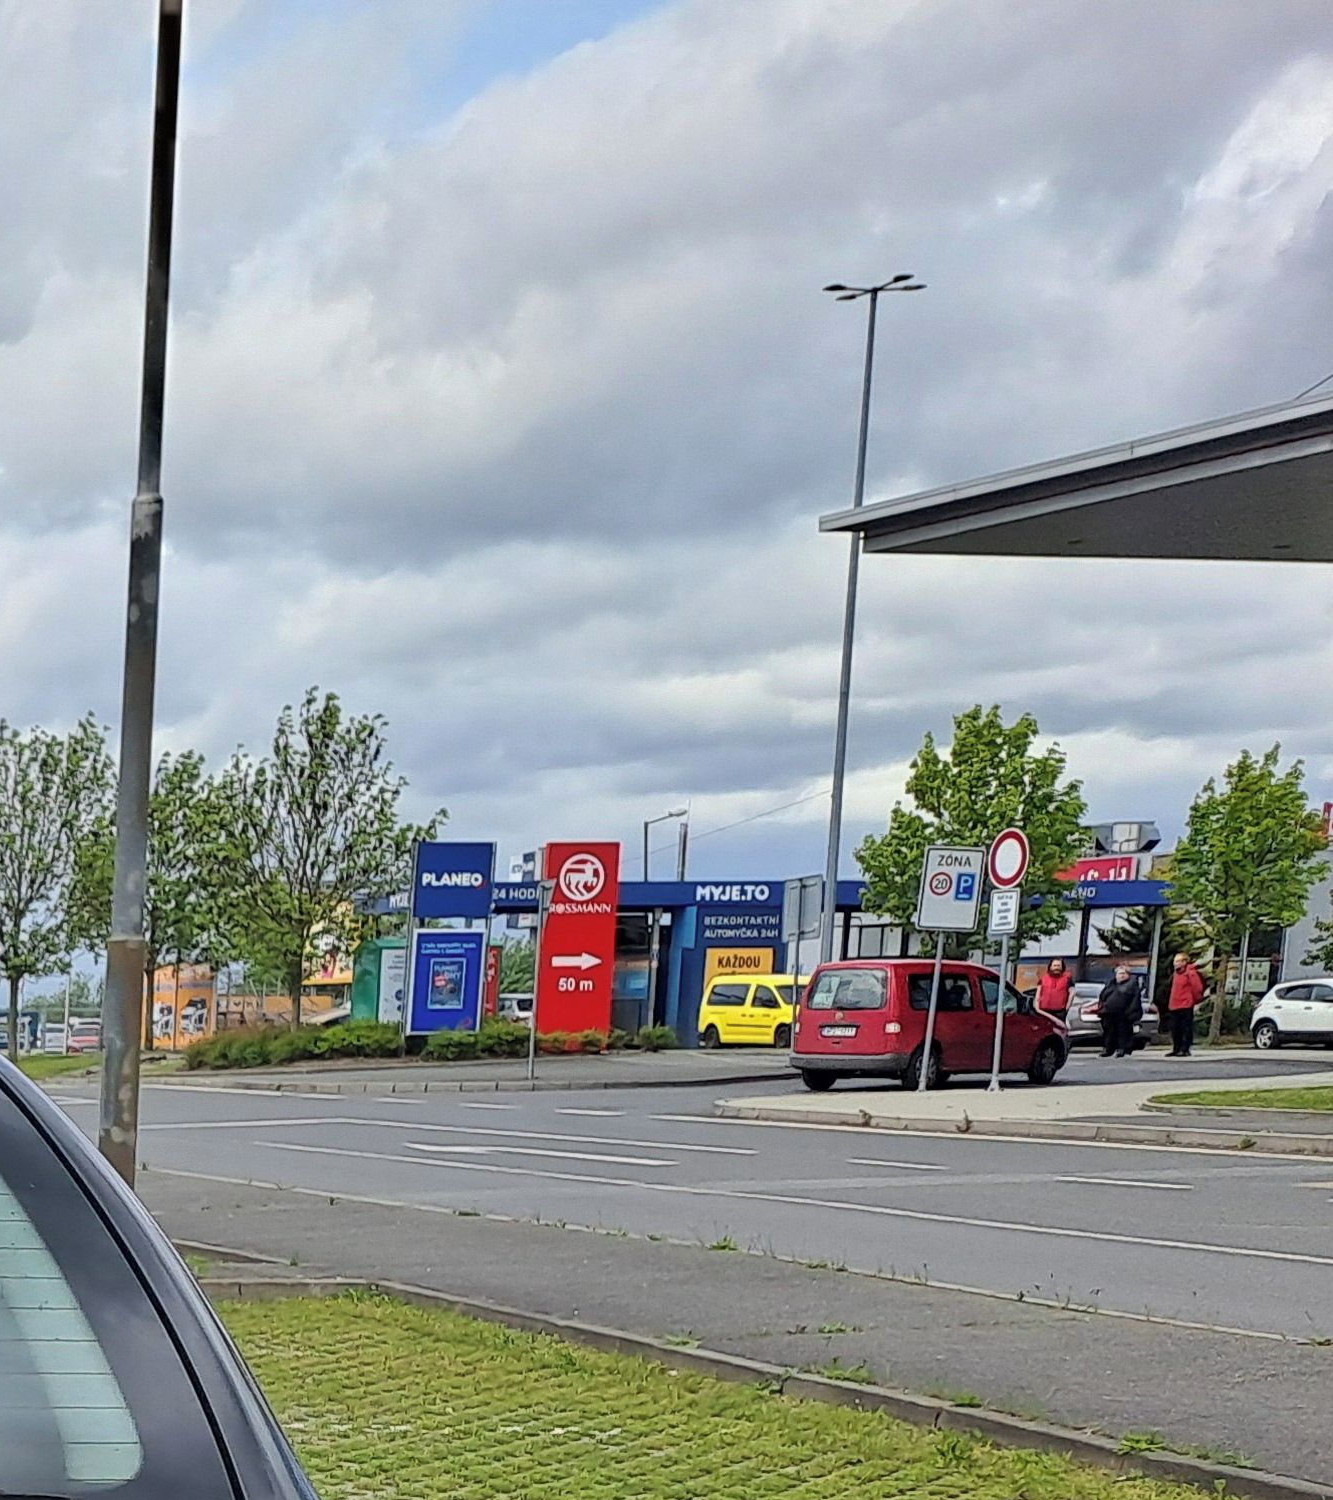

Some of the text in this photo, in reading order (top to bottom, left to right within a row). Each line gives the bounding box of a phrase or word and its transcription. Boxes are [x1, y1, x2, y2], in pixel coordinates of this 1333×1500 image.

[937, 853, 972, 867] ZÓNA
[421, 872, 483, 887] PLANEO
[934, 878, 948, 889] 20
[493, 888, 506, 900] 24
[696, 884, 769, 901] MYJE.TO
[549, 903, 612, 914] ROSSMANN
[704, 915, 780, 926] BEZKONTAKTNÍ
[704, 927, 779, 938] AUTOMYČKA 24H
[717, 954, 761, 968] KAŽDOU
[558, 978, 593, 992] 50 m
